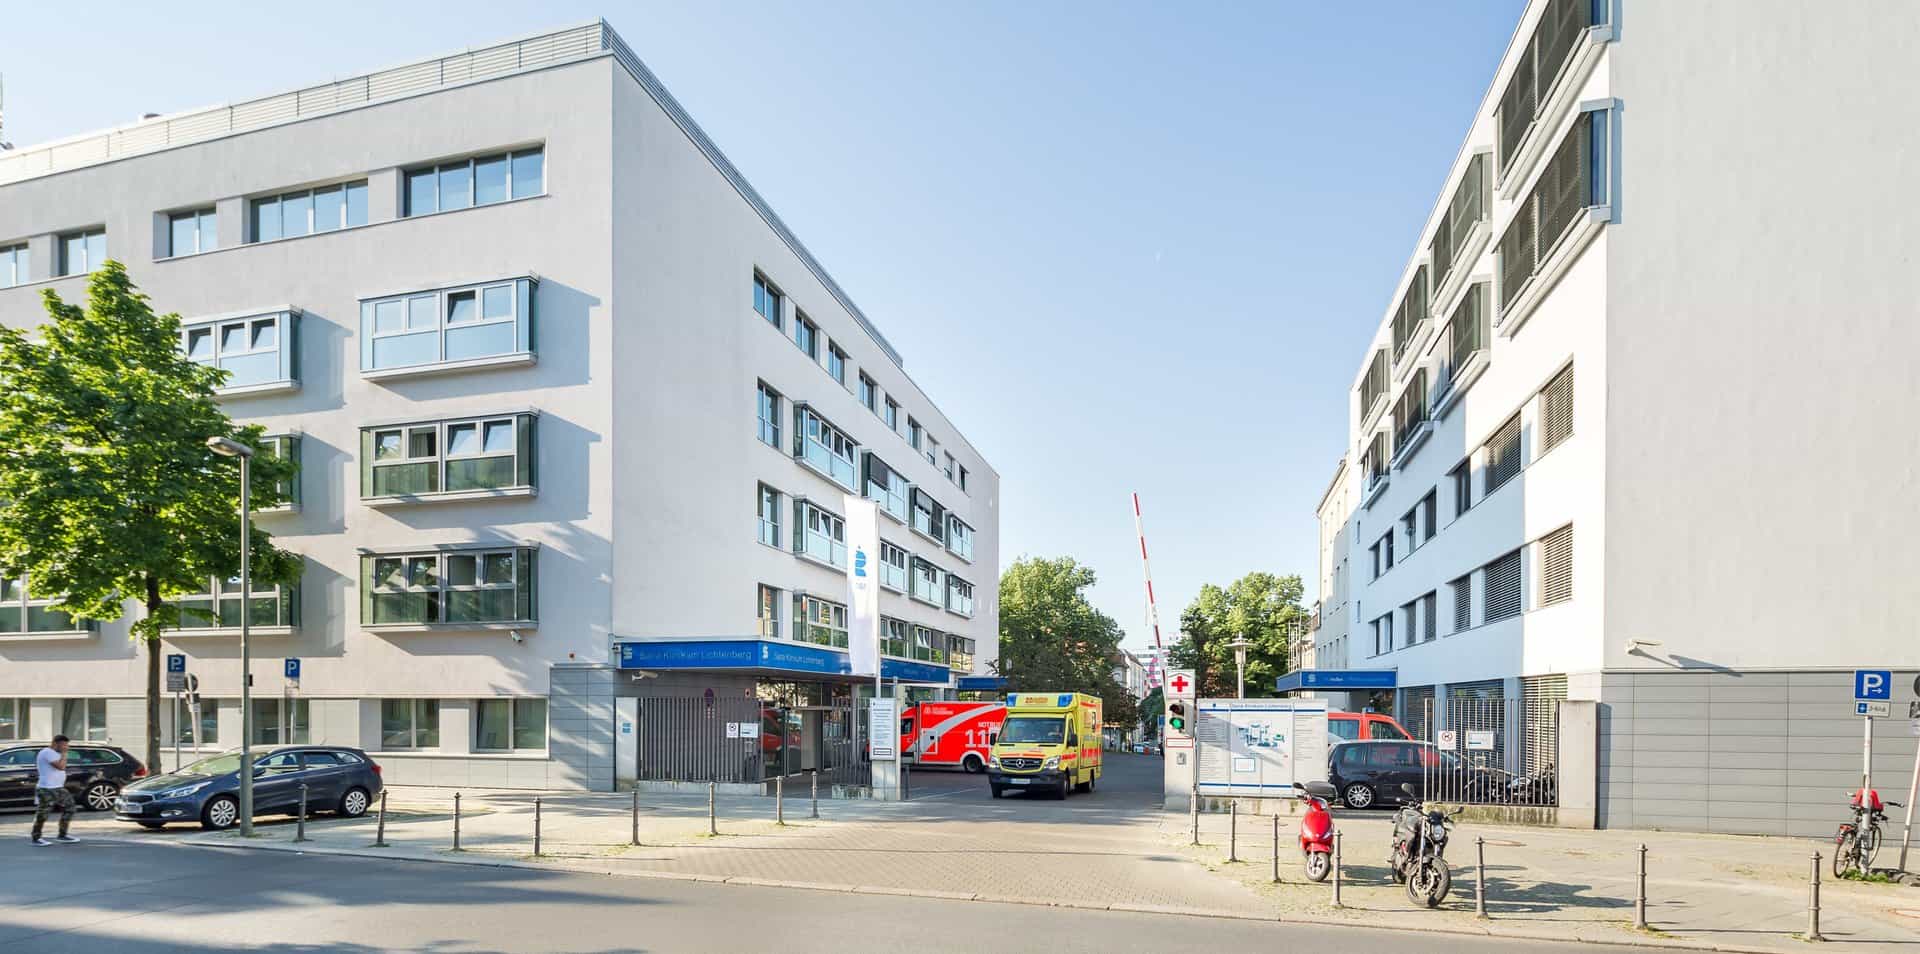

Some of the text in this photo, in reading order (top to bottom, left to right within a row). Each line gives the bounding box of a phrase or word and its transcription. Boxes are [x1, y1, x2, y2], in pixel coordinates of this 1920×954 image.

[171, 656, 182, 670] P
[288, 661, 297, 675] P
[1863, 673, 1883, 696] P
